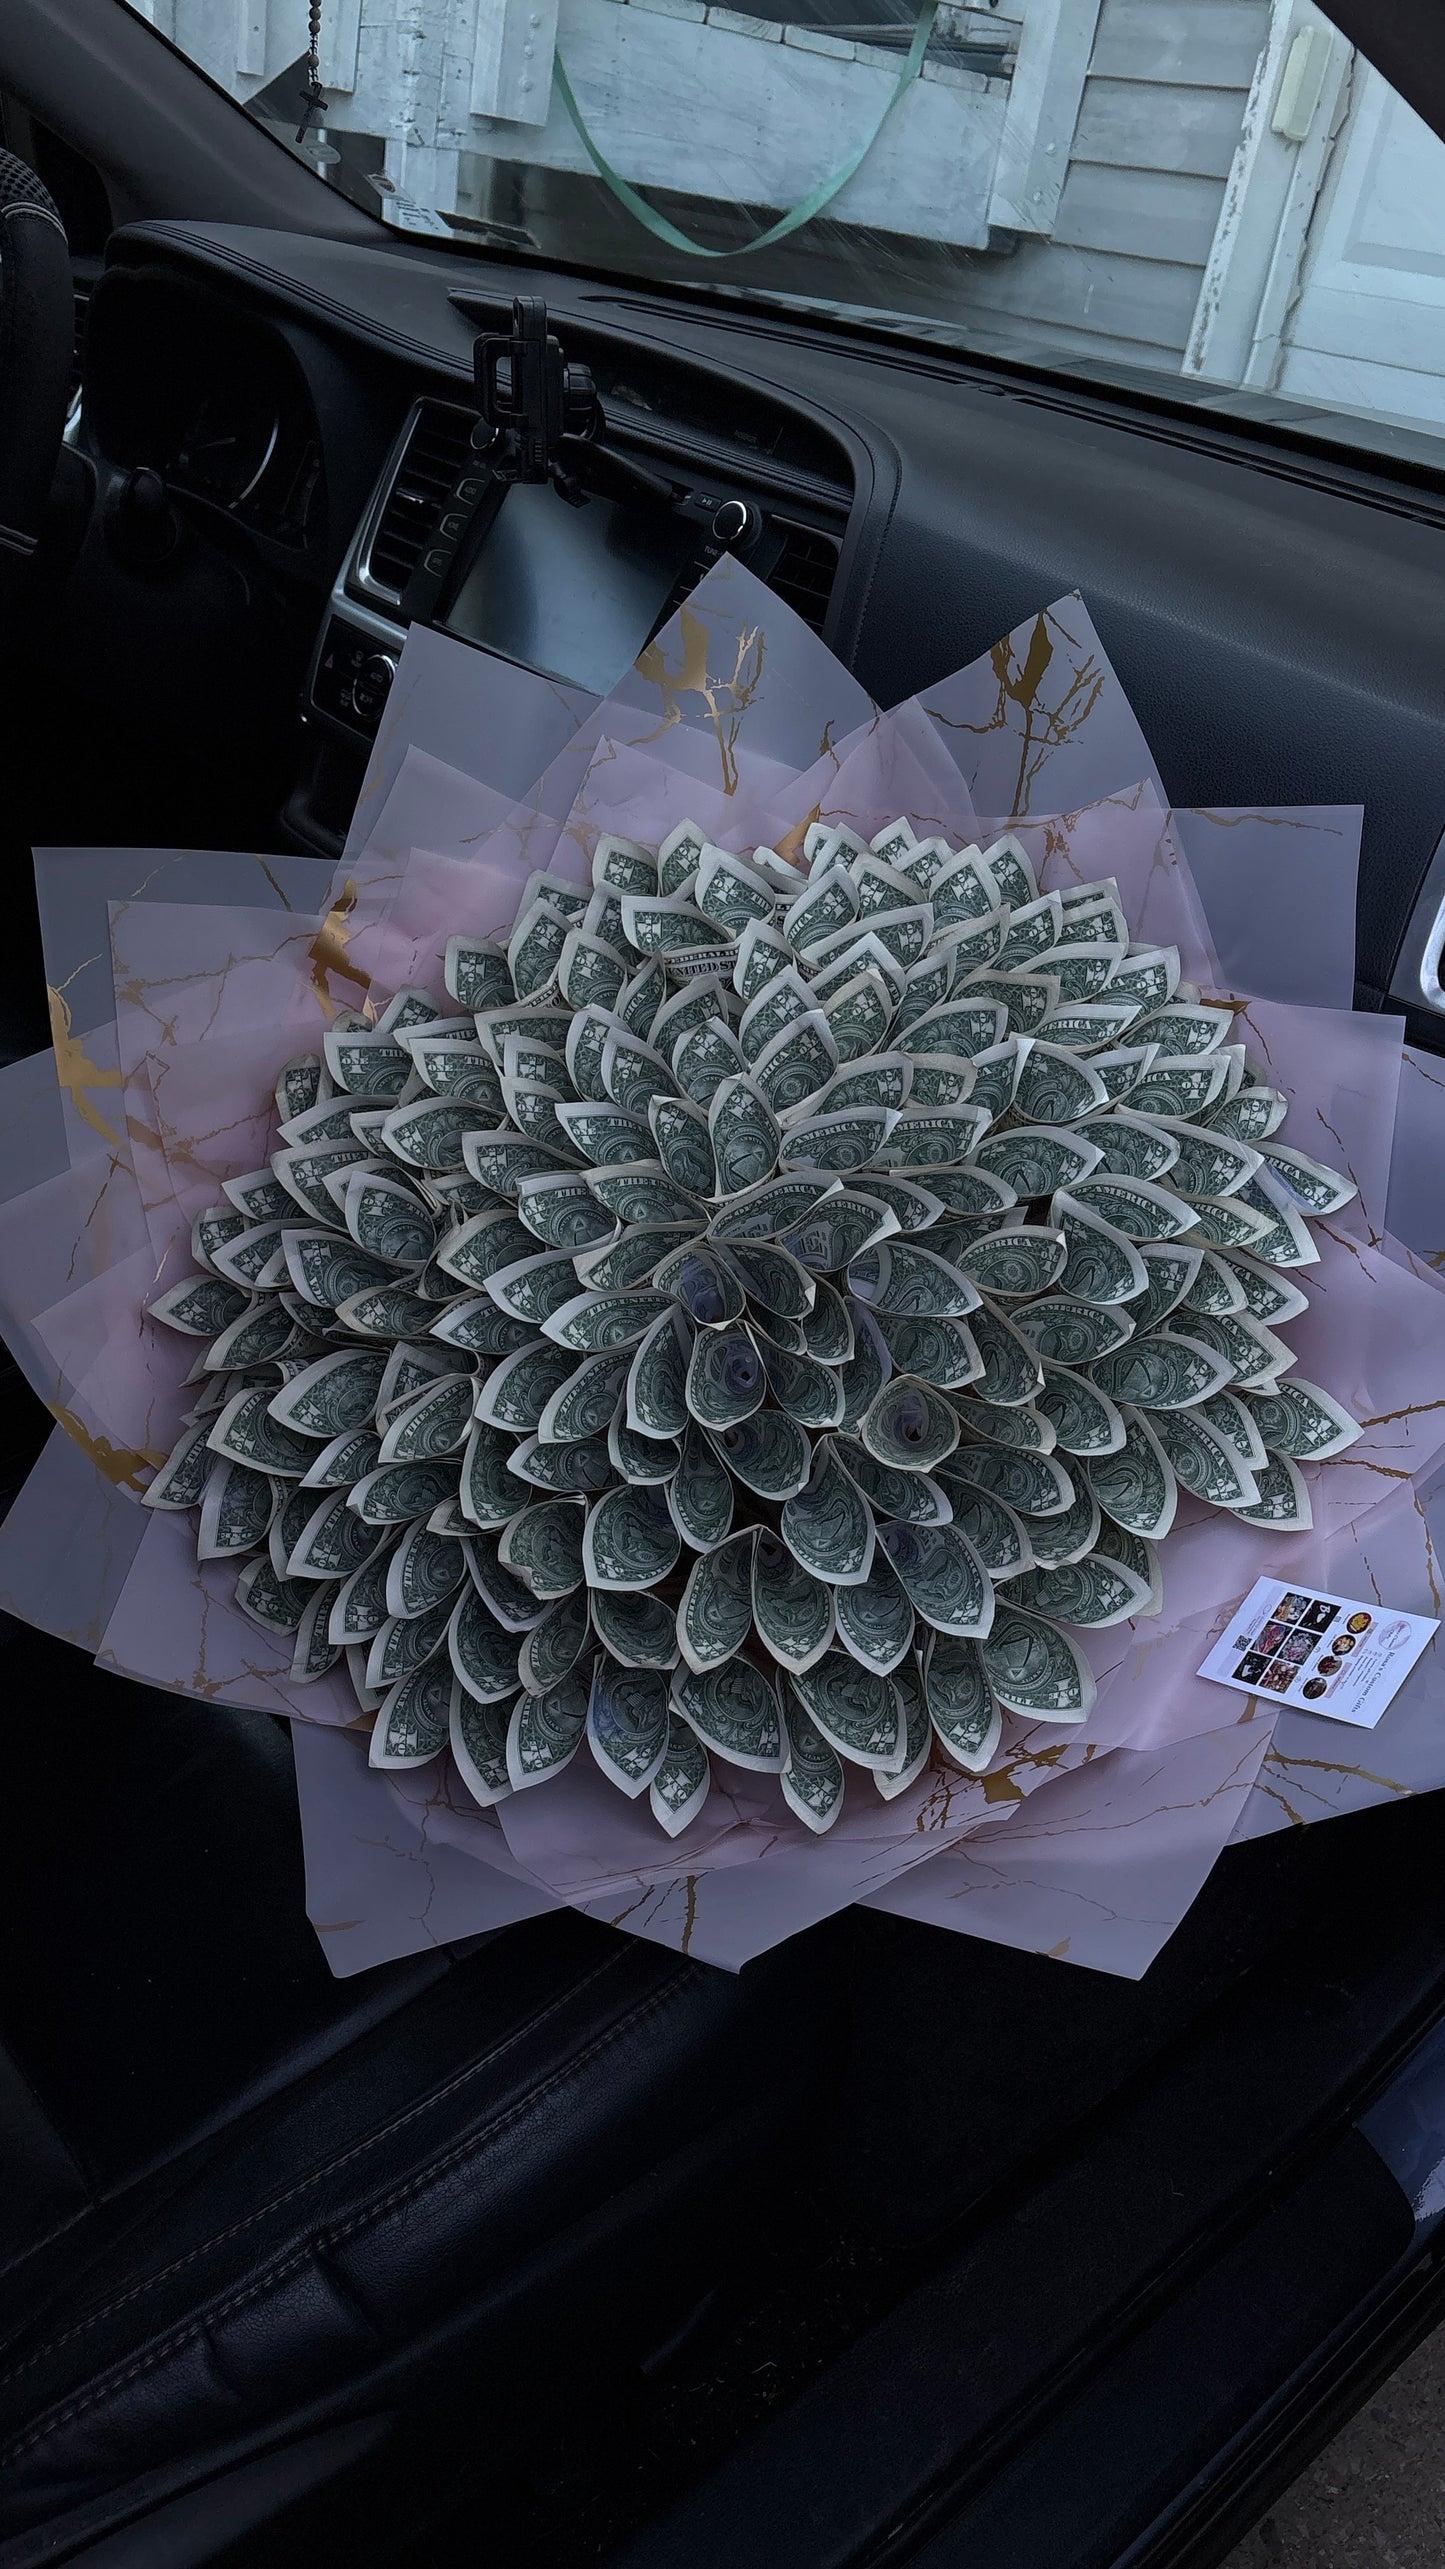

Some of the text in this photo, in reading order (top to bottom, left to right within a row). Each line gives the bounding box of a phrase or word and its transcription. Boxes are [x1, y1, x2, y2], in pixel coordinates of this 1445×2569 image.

[714, 878, 739, 897] ONE
[1086, 923, 1112, 937] ONE
[577, 956, 601, 971] ONE
[1136, 976, 1164, 990] ONE
[428, 1064, 453, 1072] ONE
[758, 1051, 789, 1086] ERICA
[1182, 1080, 1208, 1090] ONE
[518, 1104, 543, 1112] ONE
[609, 1118, 633, 1127] THE
[573, 1126, 596, 1136] ONE
[296, 1168, 323, 1179] ONE
[1268, 1158, 1301, 1179] RICA
[618, 1178, 649, 1186] THE
[555, 1188, 586, 1198] THE
[1304, 1188, 1327, 1205] ONE
[364, 1199, 393, 1208] ONE
[525, 1203, 546, 1215] ONE
[1194, 1203, 1228, 1221] RICA
[1160, 1271, 1184, 1281] ONE
[1239, 1346, 1262, 1369] ONE
[1279, 1384, 1309, 1406] RICA
[405, 1409, 430, 1438] THE
[1173, 1412, 1225, 1466] AMERICA
[318, 1543, 332, 1567] ONE
[1102, 1579, 1123, 1606] ONE
[1362, 1672, 1381, 1696] Custom
[1351, 1697, 1366, 1712] Gifts
[398, 1724, 407, 1754] ONE
